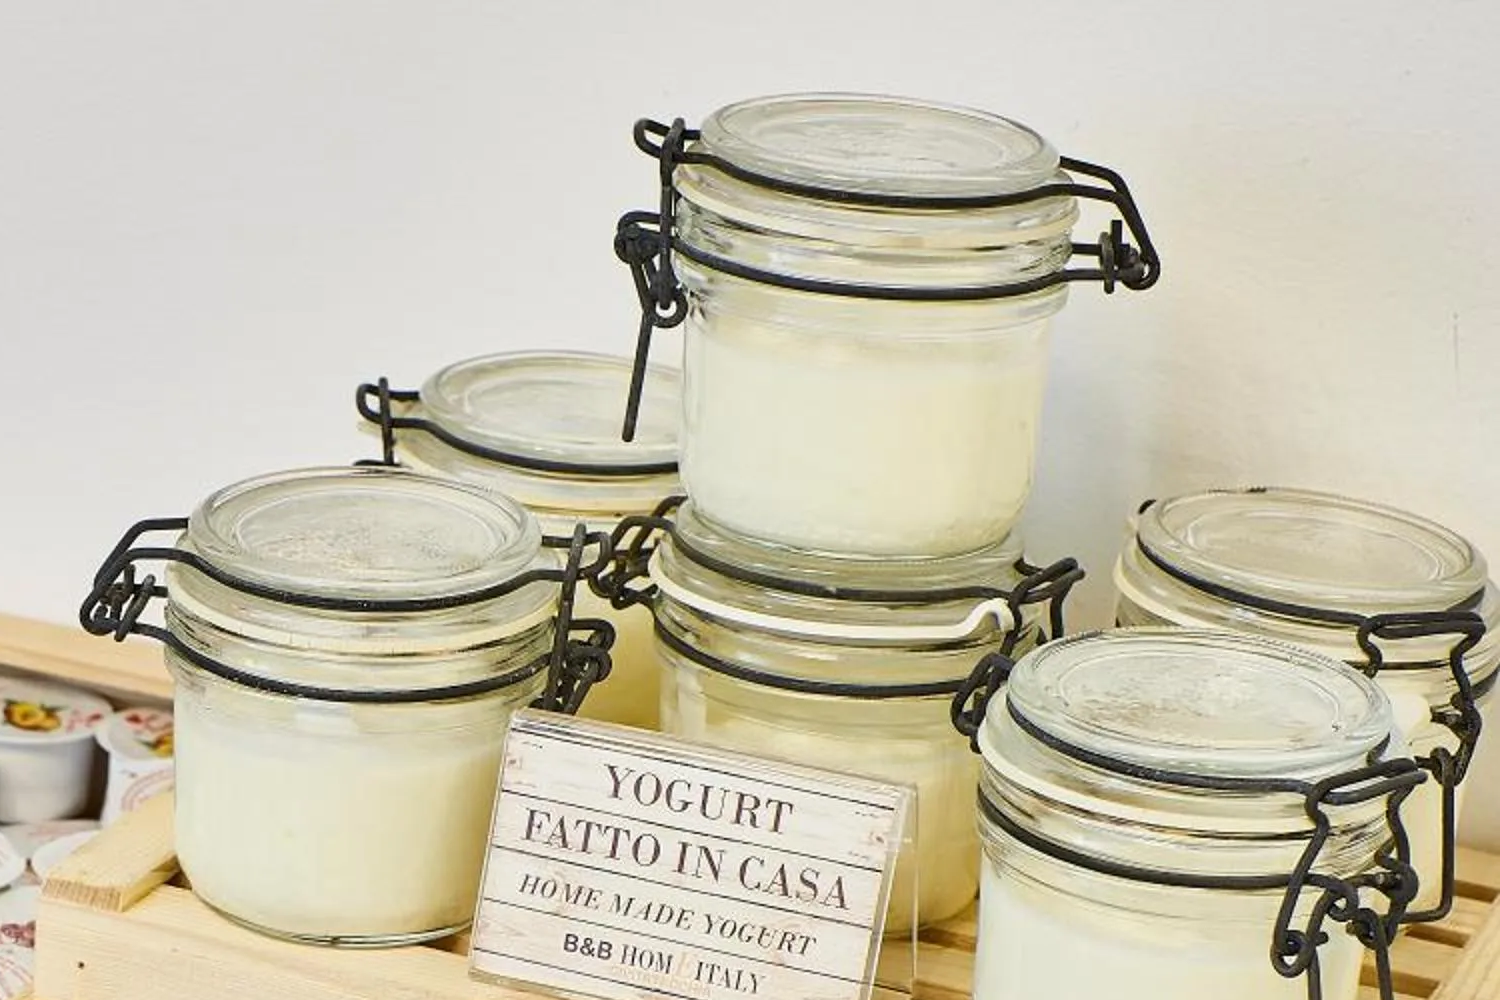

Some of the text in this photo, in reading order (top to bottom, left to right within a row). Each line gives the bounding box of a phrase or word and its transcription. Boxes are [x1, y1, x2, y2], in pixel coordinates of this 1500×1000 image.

[601, 762, 795, 836] YOGURT
[520, 807, 851, 912] FATTO IN CASA
[518, 873, 820, 959] HOME MADE YOGURT
[562, 932, 614, 961] B&B
[694, 960, 767, 995] ITALY
